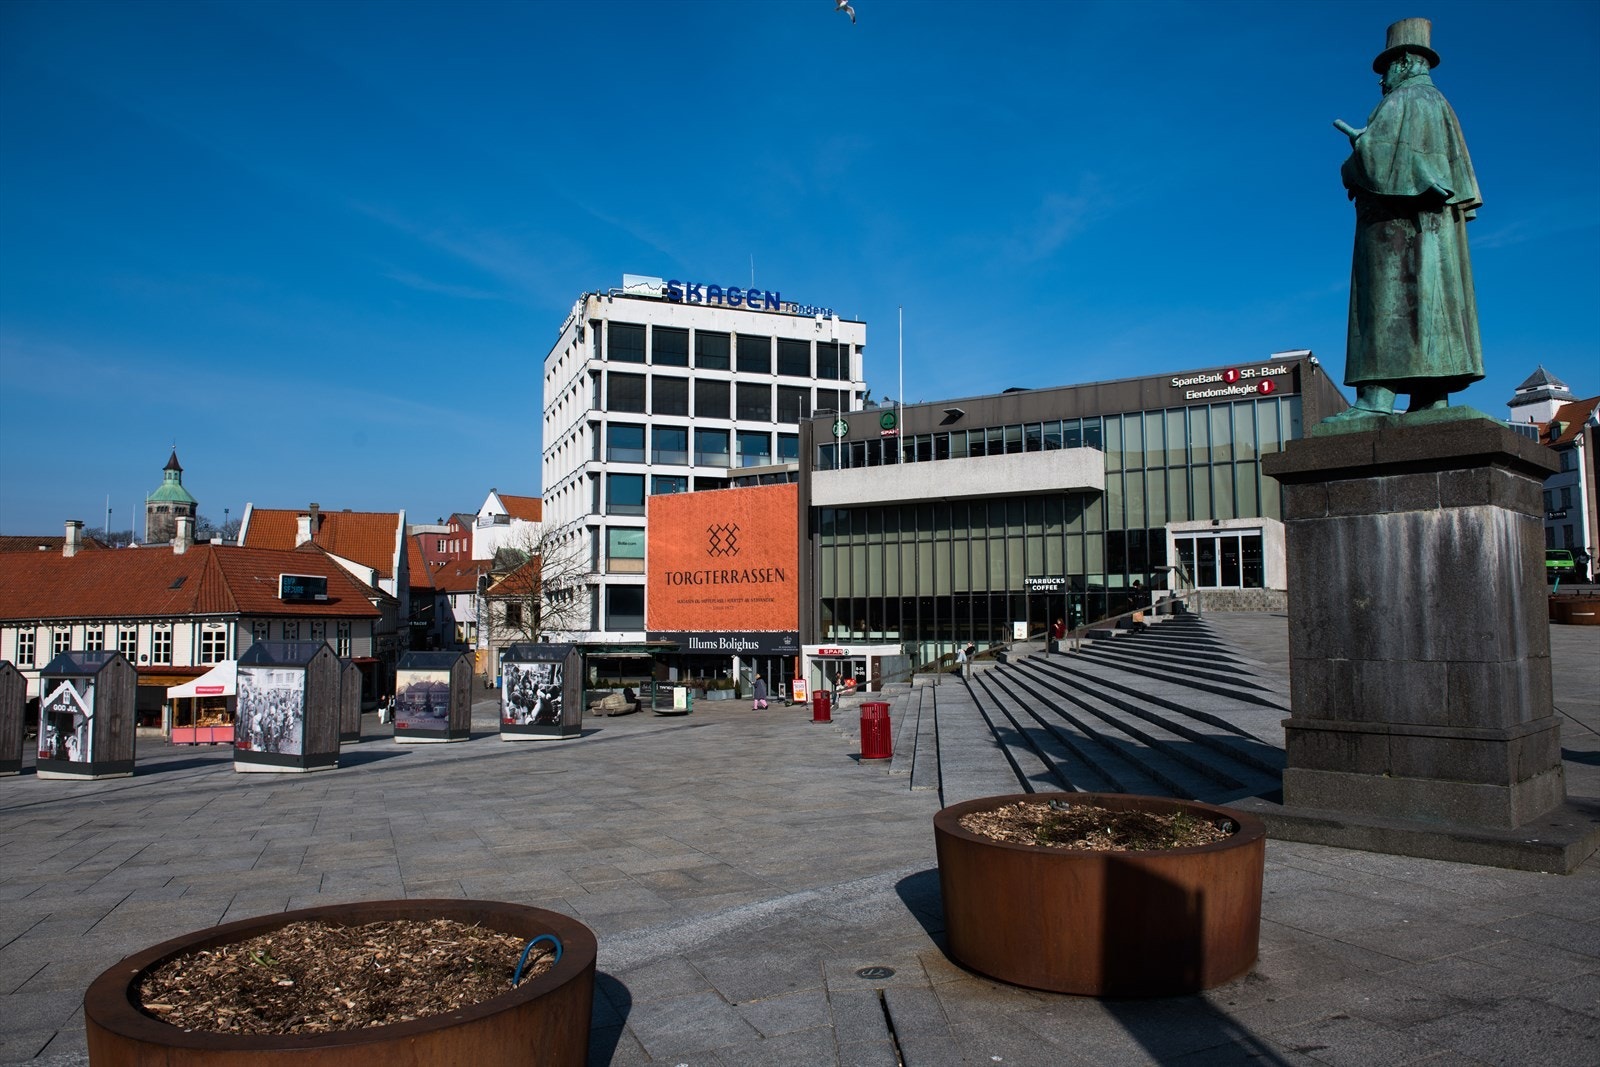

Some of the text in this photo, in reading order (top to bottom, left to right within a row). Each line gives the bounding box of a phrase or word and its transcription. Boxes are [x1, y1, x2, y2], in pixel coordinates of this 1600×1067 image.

[667, 279, 781, 311] SKAGEN
[1171, 373, 1223, 388] SpareBank
[1240, 365, 1287, 379] SR-Bank
[1186, 384, 1258, 400] EiendomsMegler
[664, 567, 785, 586] TORGTERRASSEN
[688, 637, 718, 650] Illums
[718, 637, 760, 652] Bolighus
[67, 705, 78, 713] JUL
